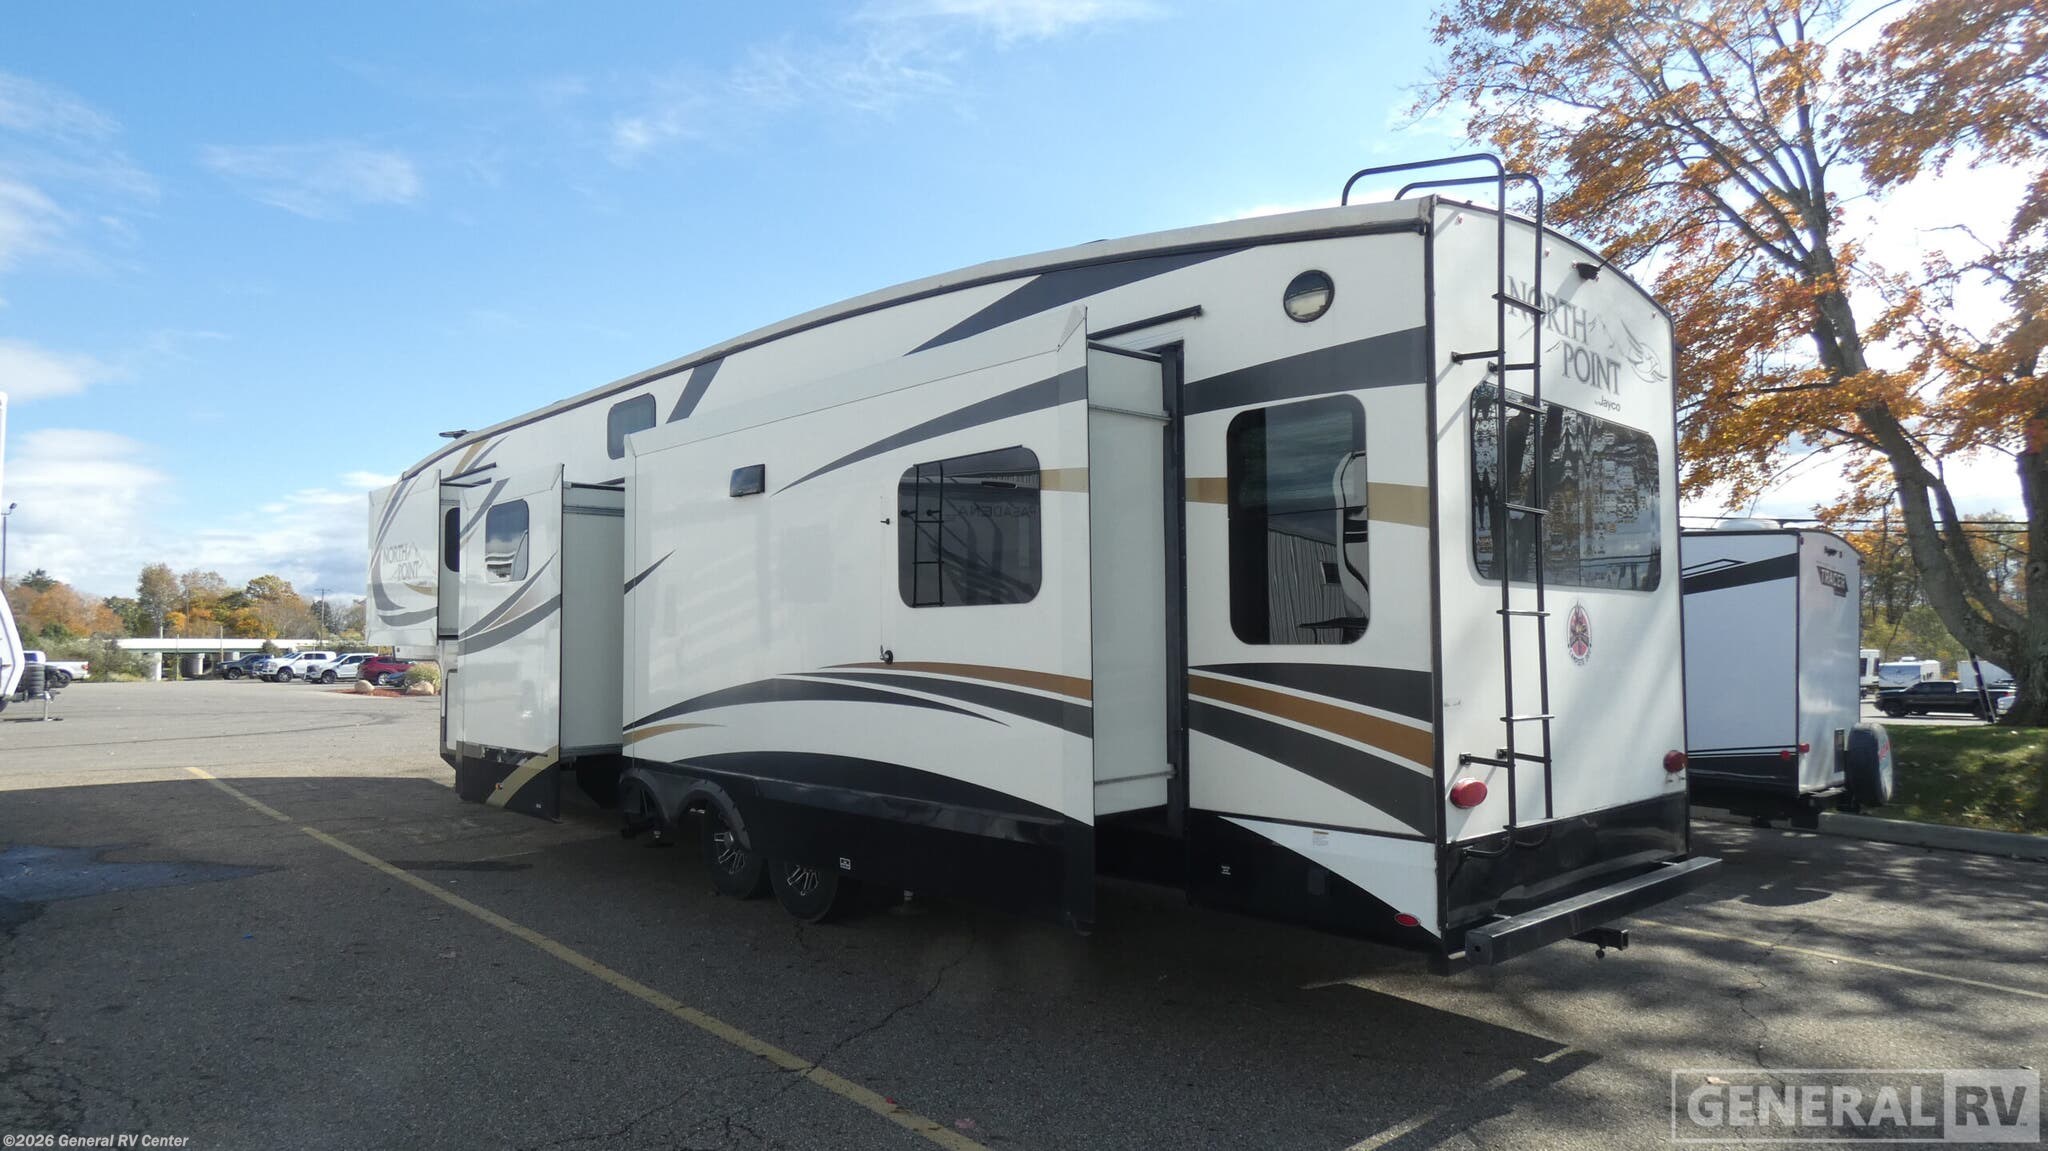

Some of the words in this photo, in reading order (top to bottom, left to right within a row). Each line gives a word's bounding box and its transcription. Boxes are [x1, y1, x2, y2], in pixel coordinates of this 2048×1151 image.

[1508, 275, 1588, 346] NORTH
[1562, 341, 1621, 395] POINT
[1599, 395, 1621, 412] Jayco
[383, 543, 409, 564] NORTH
[397, 560, 420, 581] POINT
